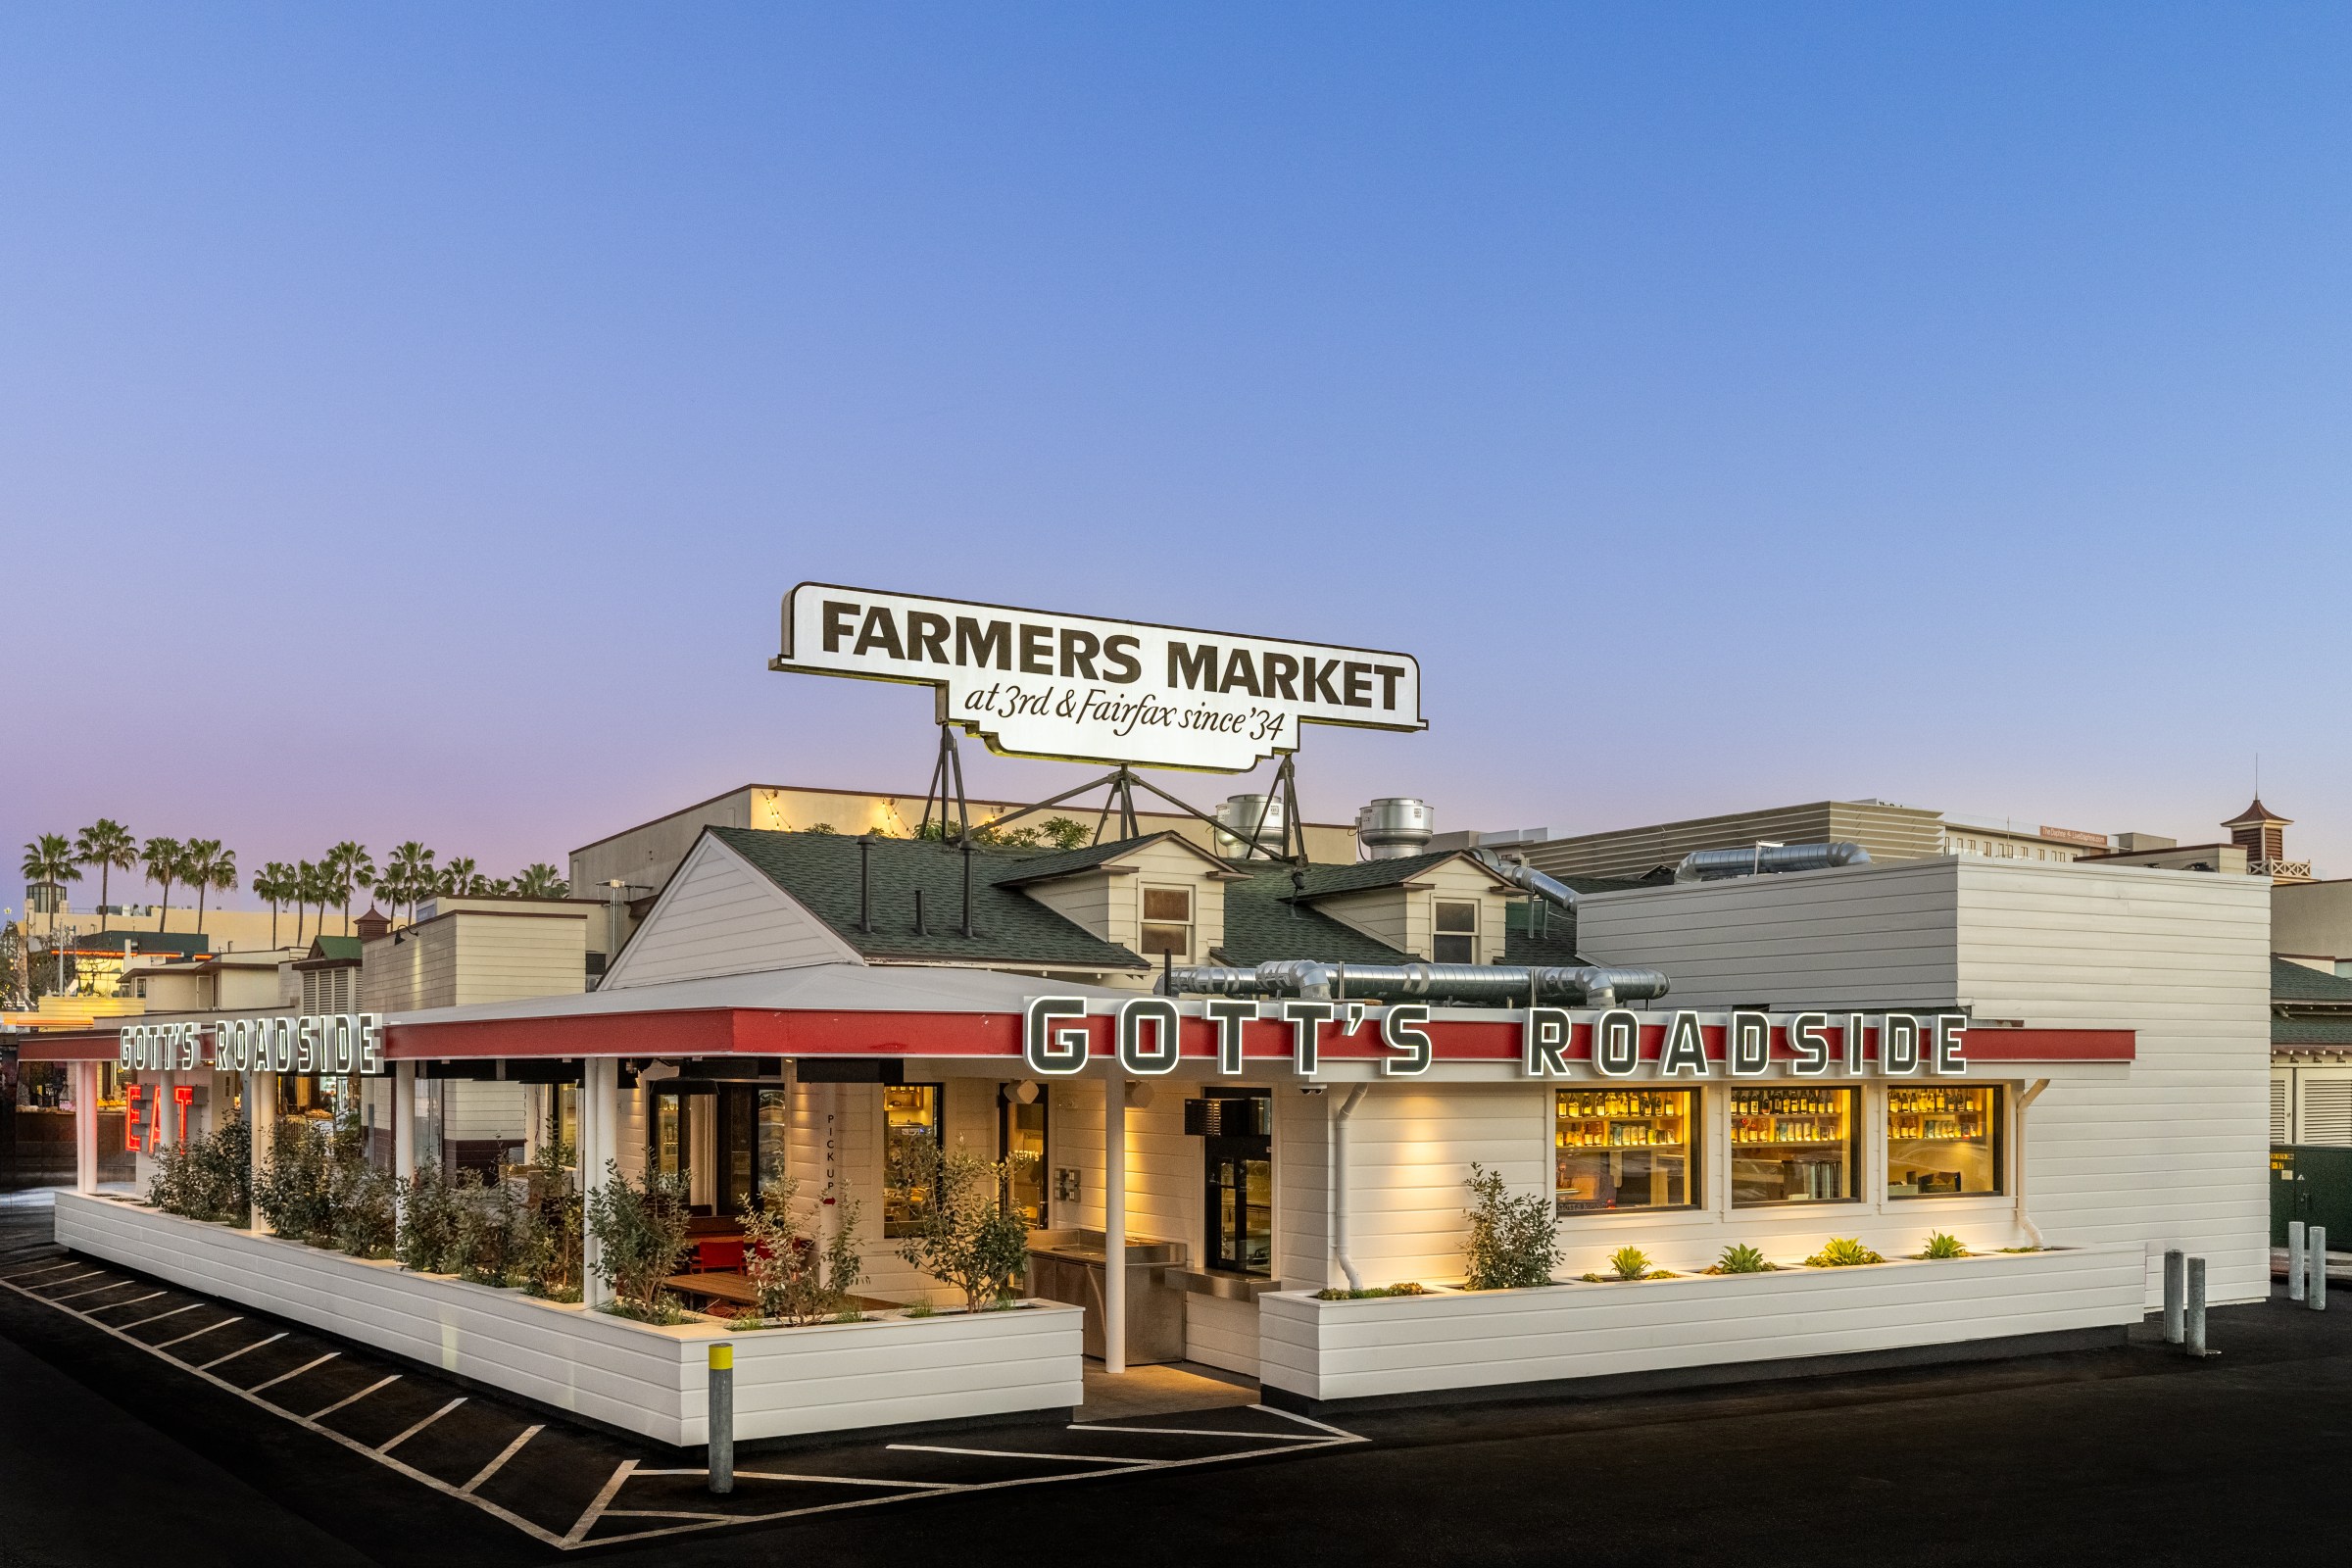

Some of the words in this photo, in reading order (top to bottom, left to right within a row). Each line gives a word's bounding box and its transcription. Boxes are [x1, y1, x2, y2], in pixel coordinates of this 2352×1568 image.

[823, 600, 1142, 684] FARMERS
[1167, 640, 1405, 710] MARKET
[964, 682, 1000, 711] at
[998, 685, 1054, 717] 3rd
[1055, 689, 1077, 717] &
[1075, 688, 1178, 736] Fairfax
[120, 1021, 196, 1071] GOTT'S
[215, 1013, 378, 1074] ROADSIDE
[1026, 995, 1433, 1076] GOTT'S
[1527, 1006, 1968, 1077] ROADSIDE
[124, 1084, 194, 1154] EAT
[826, 1114, 835, 1161] PICK
[826, 1169, 835, 1190] UP
